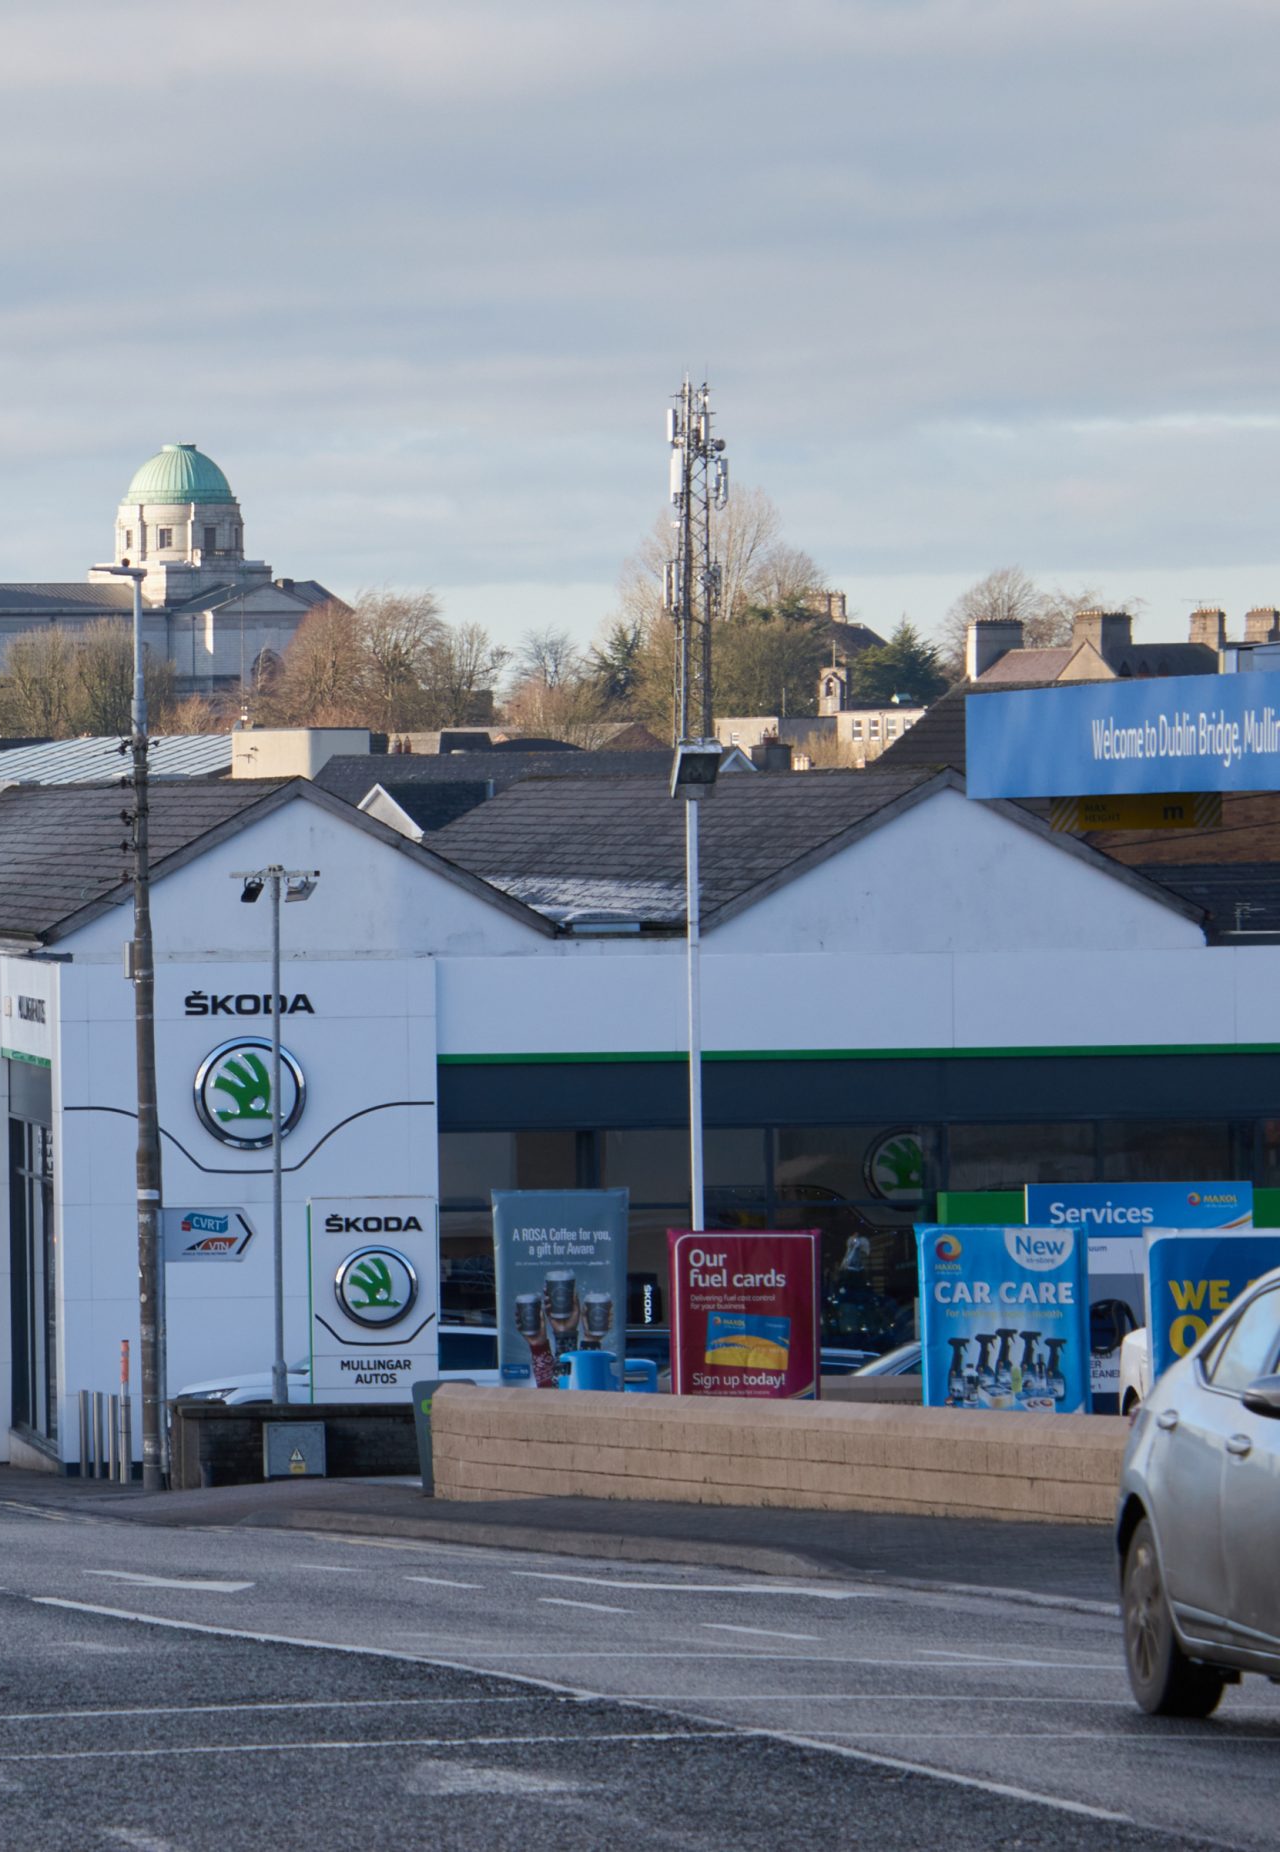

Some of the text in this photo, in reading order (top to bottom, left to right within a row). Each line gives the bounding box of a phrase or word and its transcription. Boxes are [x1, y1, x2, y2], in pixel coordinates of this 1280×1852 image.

[1091, 716, 1144, 760] Welcome
[1145, 719, 1157, 758] to
[1158, 711, 1197, 757] Dublin
[1199, 709, 1241, 768] Bridge,
[1084, 813, 1120, 823] HEIGHT
[184, 990, 315, 1016] ŠKODA
[1050, 1201, 1154, 1225] Services
[192, 1216, 221, 1230] CVRT
[325, 1213, 423, 1233] ŠKODA
[512, 1228, 520, 1241] A
[521, 1228, 548, 1241] ROSA
[549, 1228, 577, 1241] Coffee
[578, 1228, 591, 1241] for
[208, 1241, 229, 1251] VTN
[528, 1242, 595, 1258] a gift for Aware
[1015, 1235, 1065, 1256] New
[689, 1249, 727, 1268] Our
[689, 1268, 786, 1288] fuel cards
[690, 1293, 776, 1303] Delivering fuel cost control
[934, 1281, 1075, 1304] CAR CARE
[1168, 1279, 1230, 1311] WE
[340, 1359, 412, 1371] MULLINGAR
[355, 1373, 397, 1384] AUTOS
[692, 1372, 786, 1389] Sign up today!
